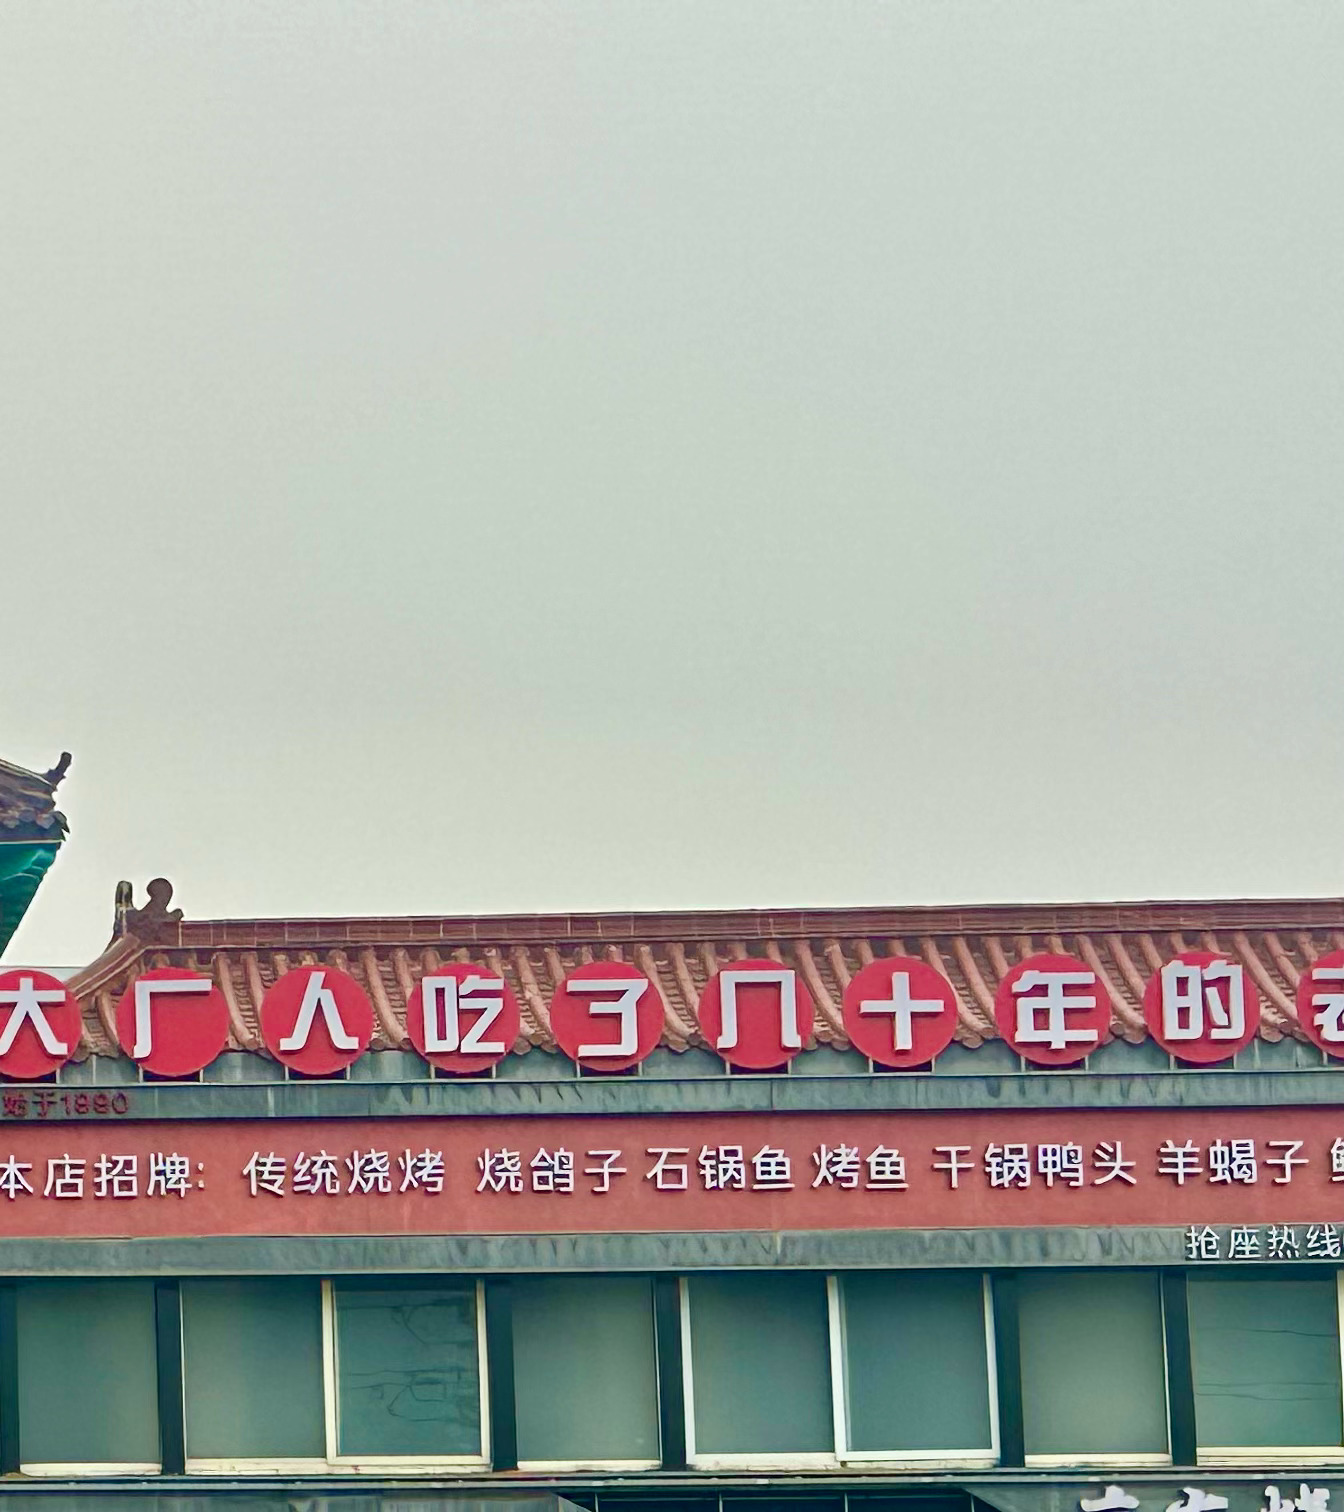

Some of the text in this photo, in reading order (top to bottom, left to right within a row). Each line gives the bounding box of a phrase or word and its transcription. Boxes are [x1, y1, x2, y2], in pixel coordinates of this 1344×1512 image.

[243, 1148, 446, 1196] 传统烧烤
[477, 1146, 628, 1194] 烧鸽子
[645, 1144, 796, 1191] 石锅鱼
[812, 1143, 910, 1190] 烤鱼
[933, 1140, 1137, 1188] 干锅鸭头
[1157, 1138, 1310, 1185] 羊蝎子
[1185, 1225, 1342, 1259] 抢座热线
